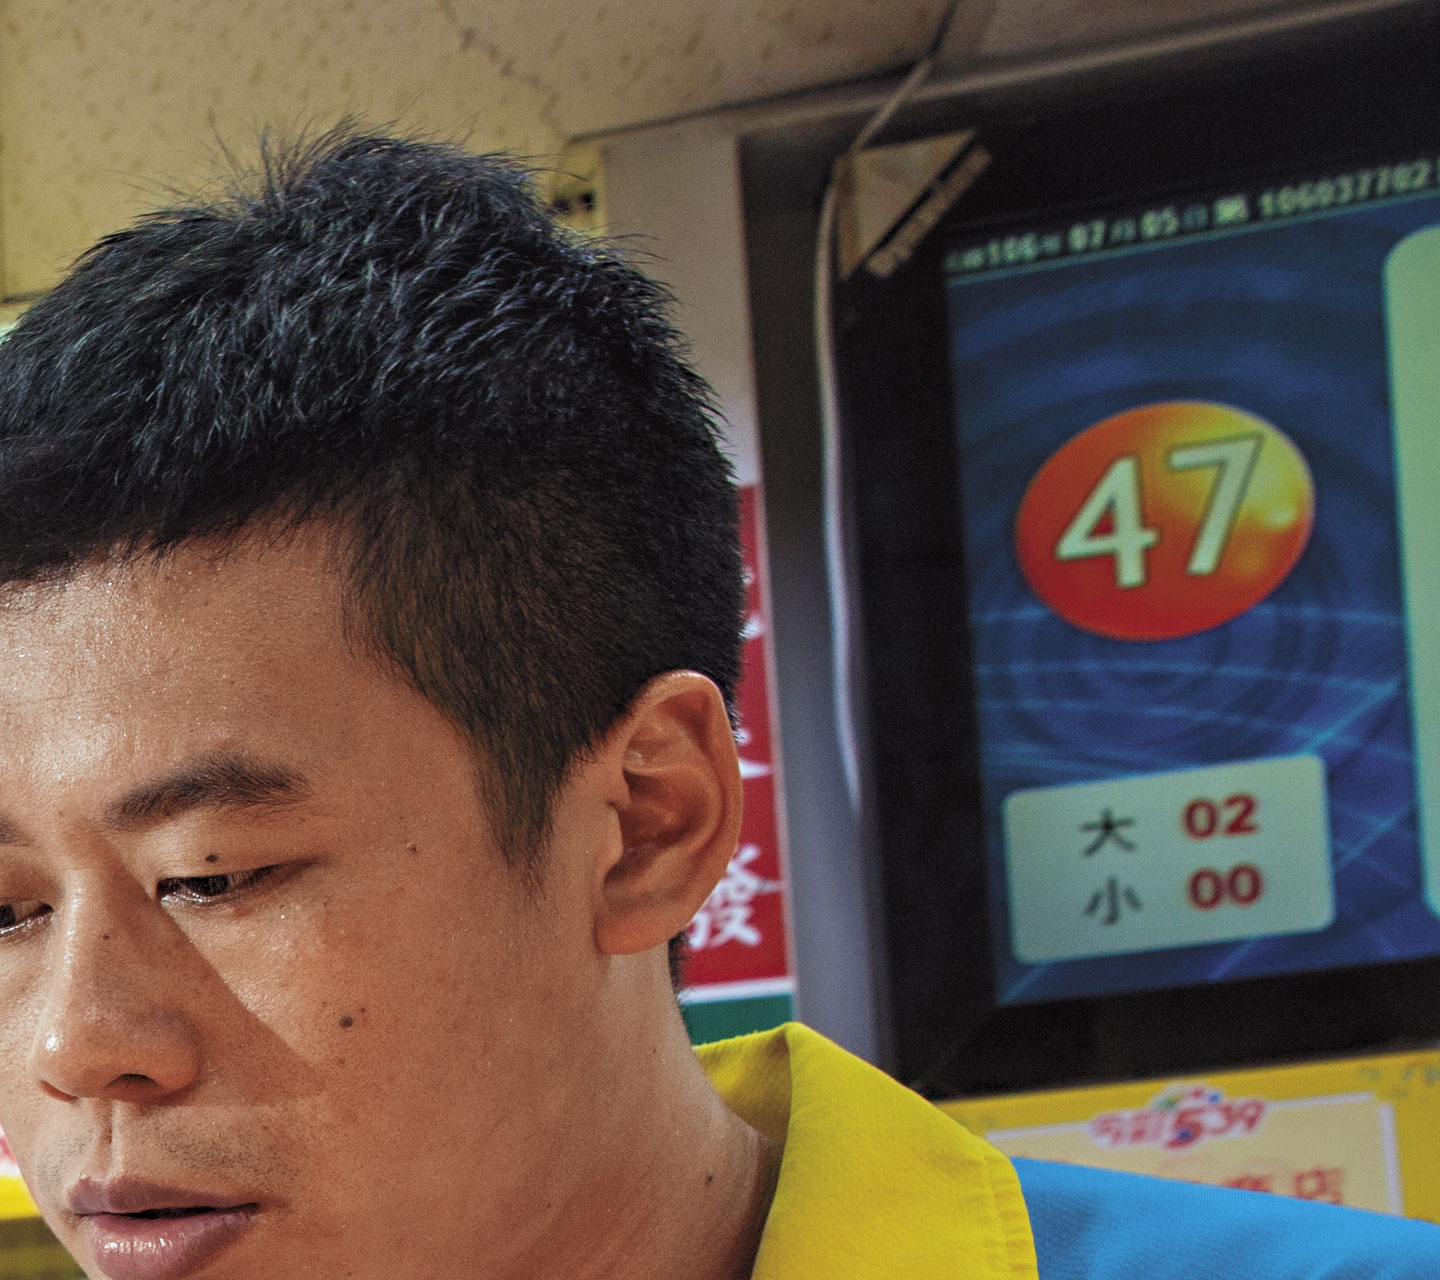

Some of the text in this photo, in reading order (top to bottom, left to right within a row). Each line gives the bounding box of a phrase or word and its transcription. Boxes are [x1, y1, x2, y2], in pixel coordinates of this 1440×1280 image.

[1055, 434, 1264, 591] 47
[1080, 794, 1260, 856] 大 02
[1084, 864, 1264, 927] 小 00
